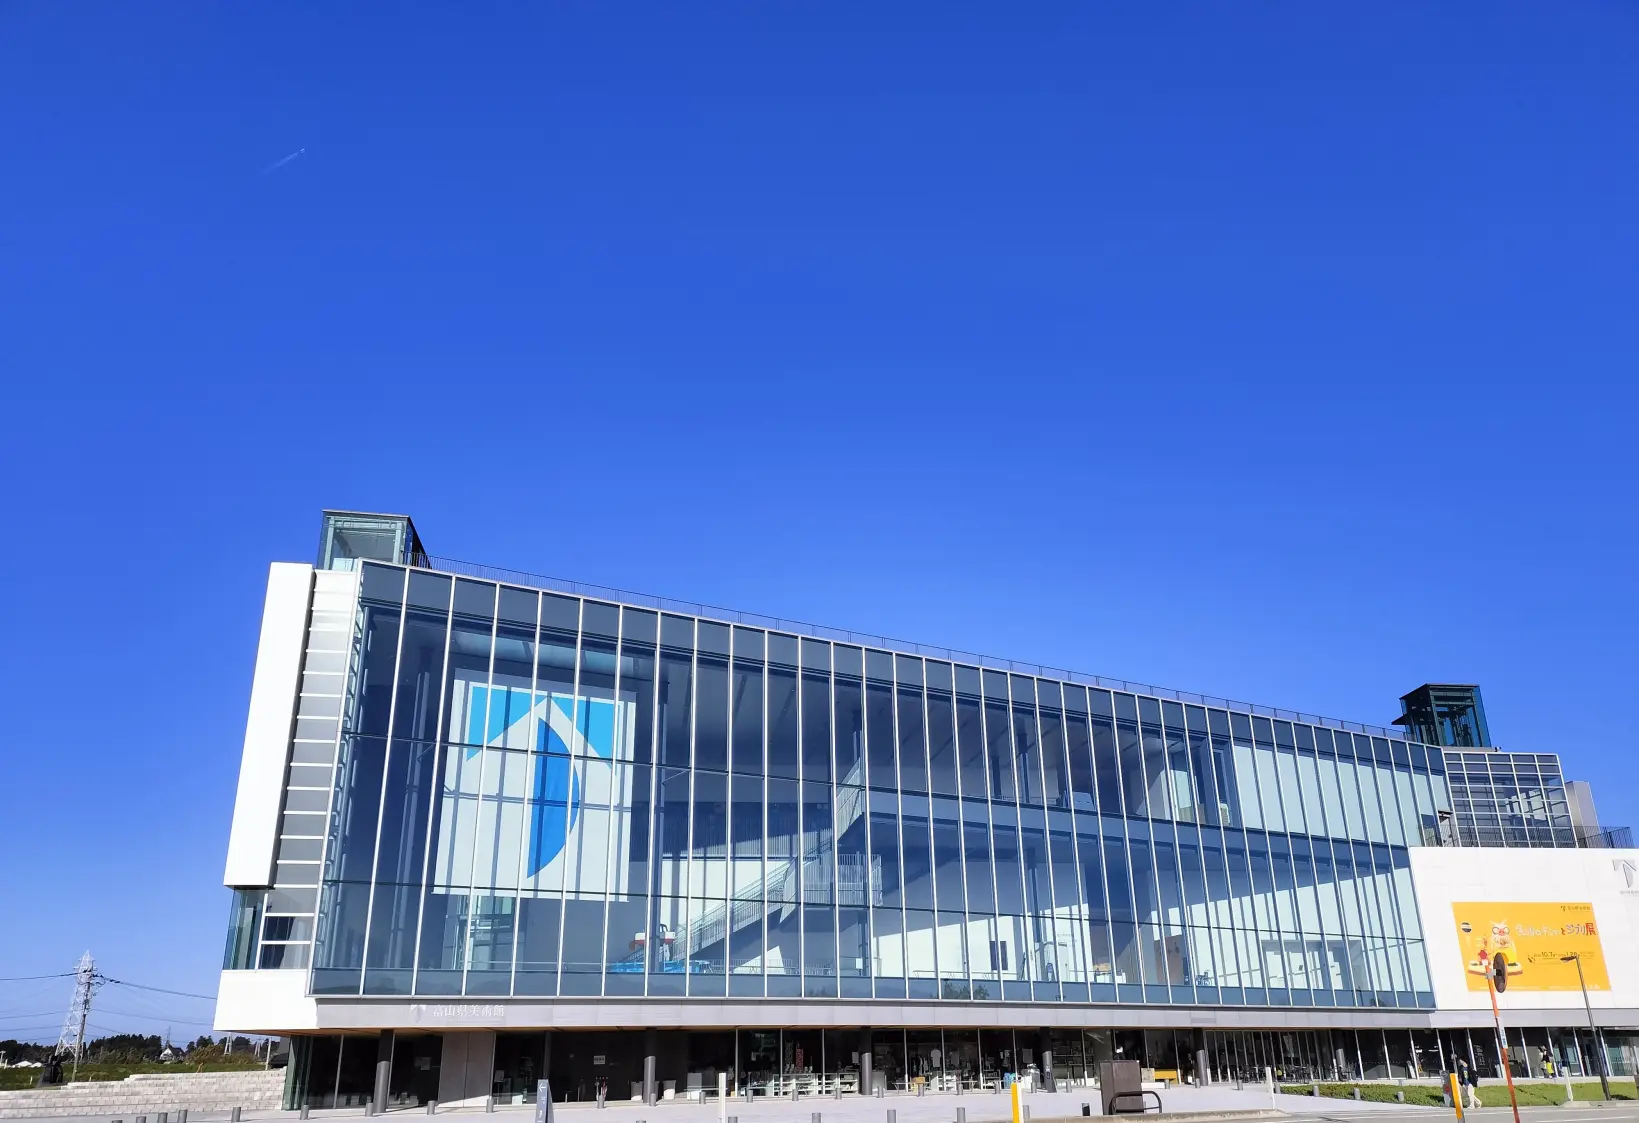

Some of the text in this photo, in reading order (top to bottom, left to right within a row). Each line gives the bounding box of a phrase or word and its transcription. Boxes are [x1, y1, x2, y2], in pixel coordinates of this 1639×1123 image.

[432, 1004, 505, 1017] 富山県美術館
